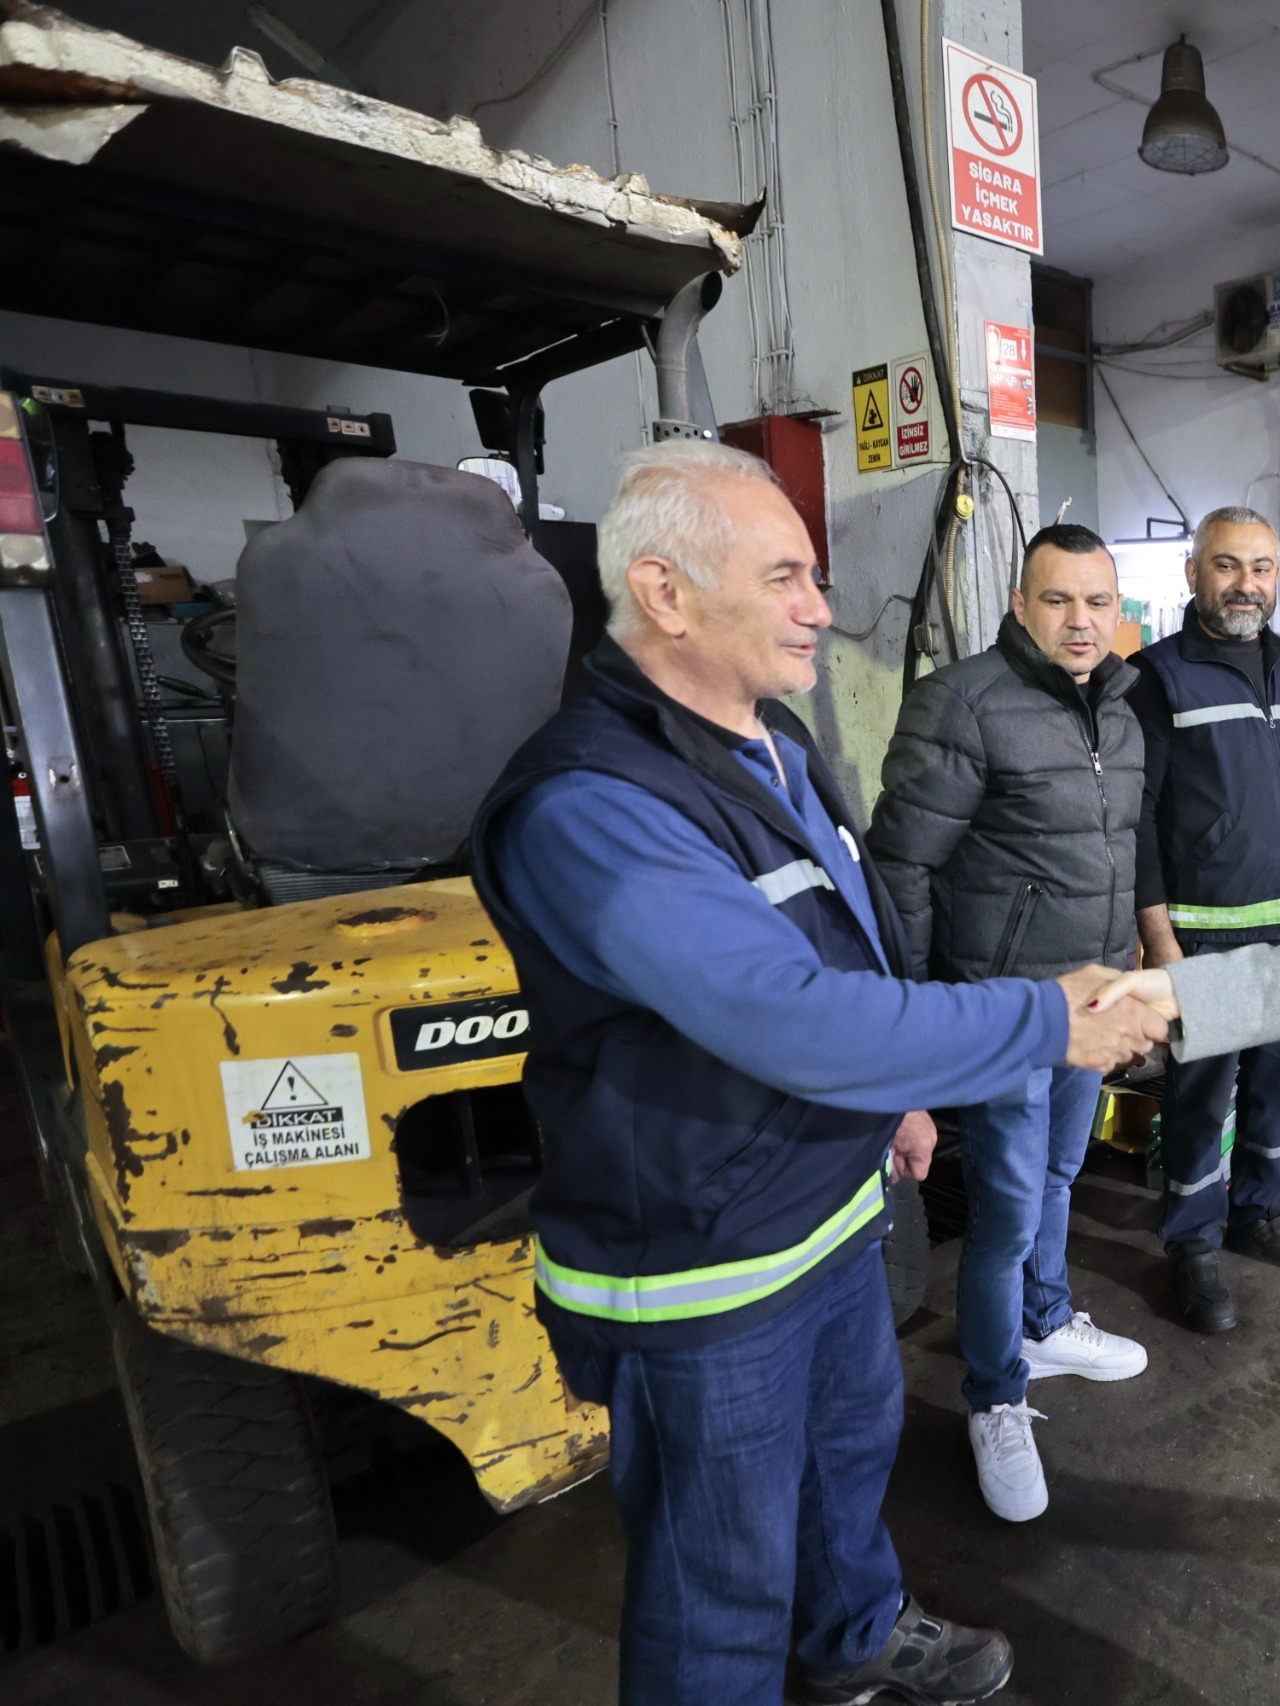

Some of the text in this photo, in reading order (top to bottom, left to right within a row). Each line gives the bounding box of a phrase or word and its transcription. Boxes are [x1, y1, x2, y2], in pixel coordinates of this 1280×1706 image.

[969, 160, 1023, 195] SİGARA
[975, 182, 1018, 216] İÇMEK
[961, 204, 1034, 242] YASAKTIR
[1002, 343, 1015, 357] 28
[863, 369, 884, 382] DİKKAT
[902, 424, 924, 440] İZİNSİZ
[859, 440, 870, 452] YAĞLI
[873, 438, 889, 449] KAYGAN
[899, 440, 928, 456] GİRİLMEZ
[868, 453, 881, 463] ZEMİN
[255, 1109, 337, 1129] DİKKAT
[253, 1123, 346, 1149] İŞ MAKİNESİ
[244, 1142, 360, 1169] ÇALIŞMA ALANI
